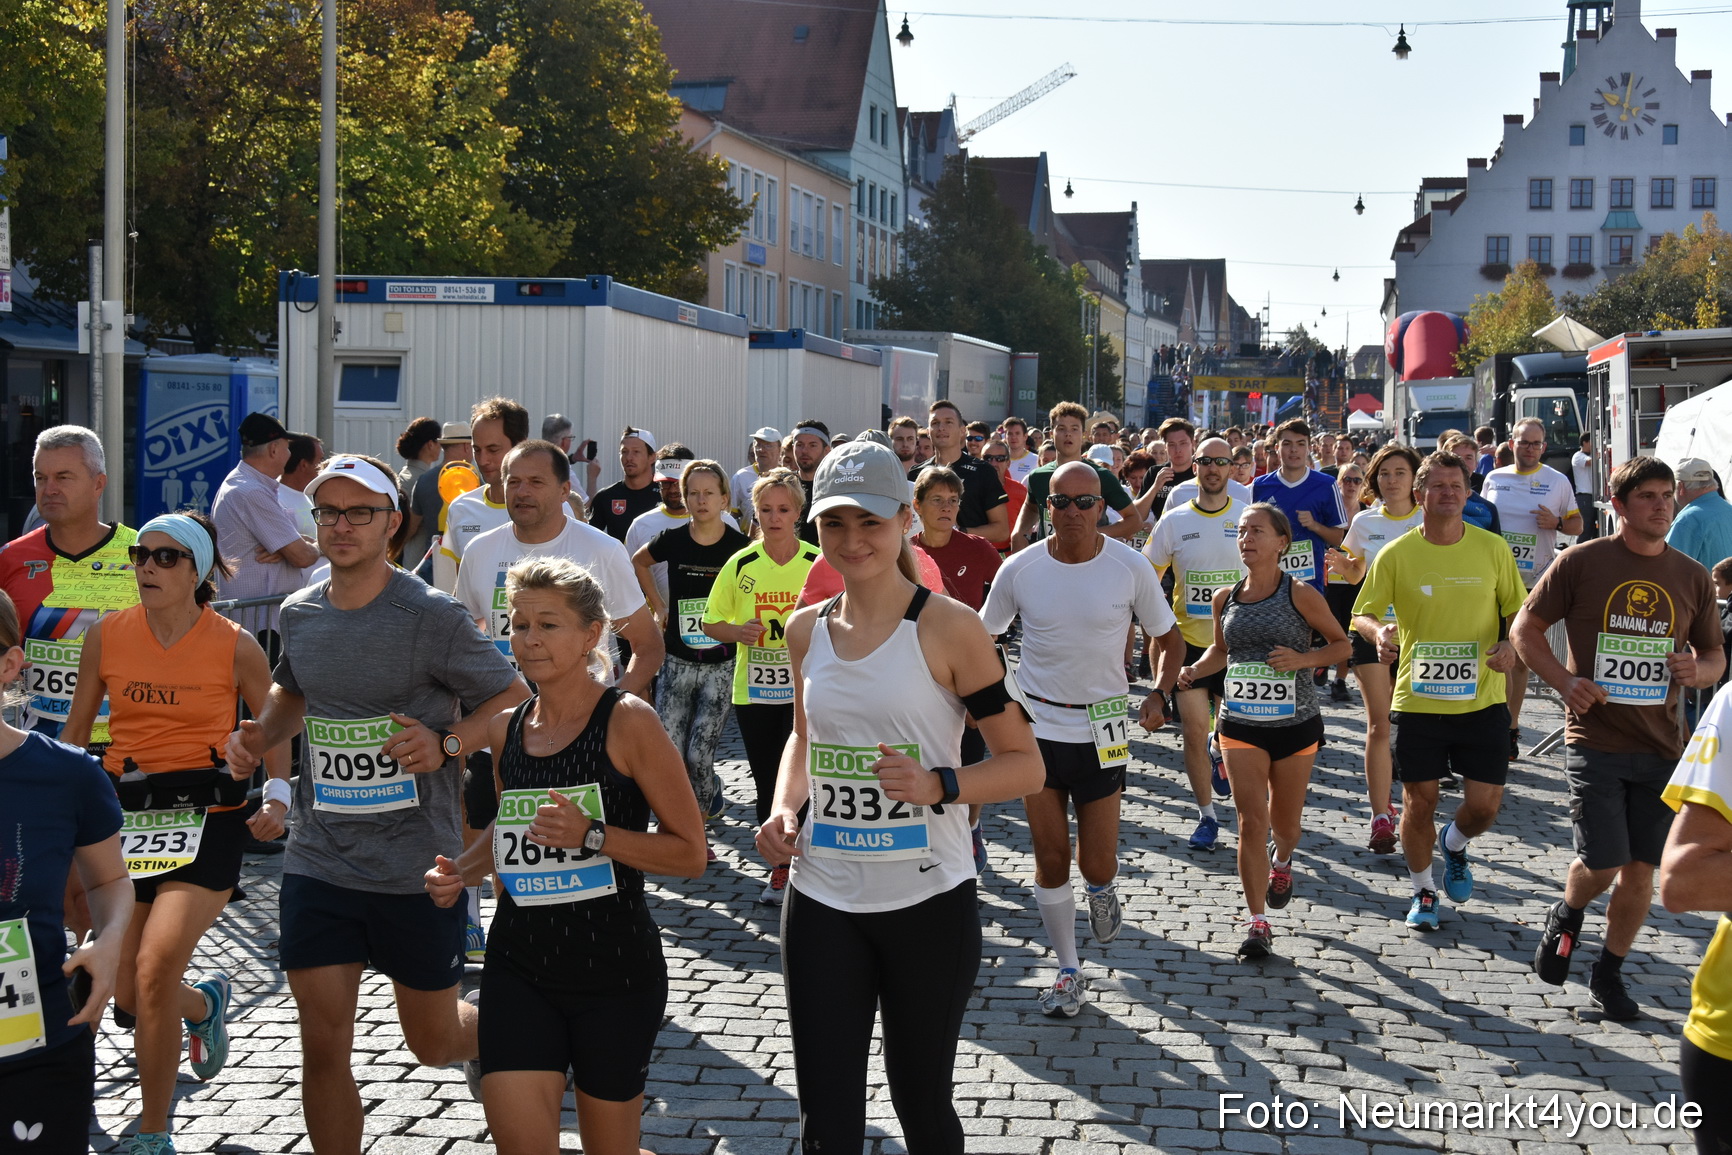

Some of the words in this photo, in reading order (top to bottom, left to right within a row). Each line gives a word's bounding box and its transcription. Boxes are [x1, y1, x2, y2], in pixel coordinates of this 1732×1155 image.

[478, 286, 486, 294] 80
[167, 381, 190, 390] 08141
[196, 383, 210, 391] 536
[213, 383, 222, 391] 80
[1229, 380, 1268, 389] START
[834, 475, 865, 484] adidas
[1282, 555, 1308, 569] 102
[1188, 571, 1237, 584] BOCK
[755, 592, 799, 604] Mülle
[1191, 588, 1221, 603] 28
[1610, 614, 1647, 632] BANANA
[1649, 620, 1668, 634] JOE
[1417, 644, 1473, 657] BOCK
[1603, 636, 1667, 656] BOCK
[753, 667, 793, 685] 233
[1231, 664, 1290, 679] BOCK
[1419, 662, 1472, 680] 2206
[1604, 658, 1665, 682] 2003
[1233, 681, 1287, 701] 2329
[1423, 685, 1467, 694] HUBERT
[1602, 684, 1662, 697] SEBASTIAN
[130, 689, 180, 706] OEXL
[1240, 705, 1280, 714] SABINE
[312, 720, 392, 745] BOCK
[319, 751, 399, 782] 2099
[321, 784, 405, 799] CHRISTOPHER
[822, 783, 911, 821] 2332
[835, 831, 895, 848] KLAUS
[503, 832, 599, 866] 264
[126, 861, 178, 870] ISTINA
[515, 874, 584, 893] GISELA
